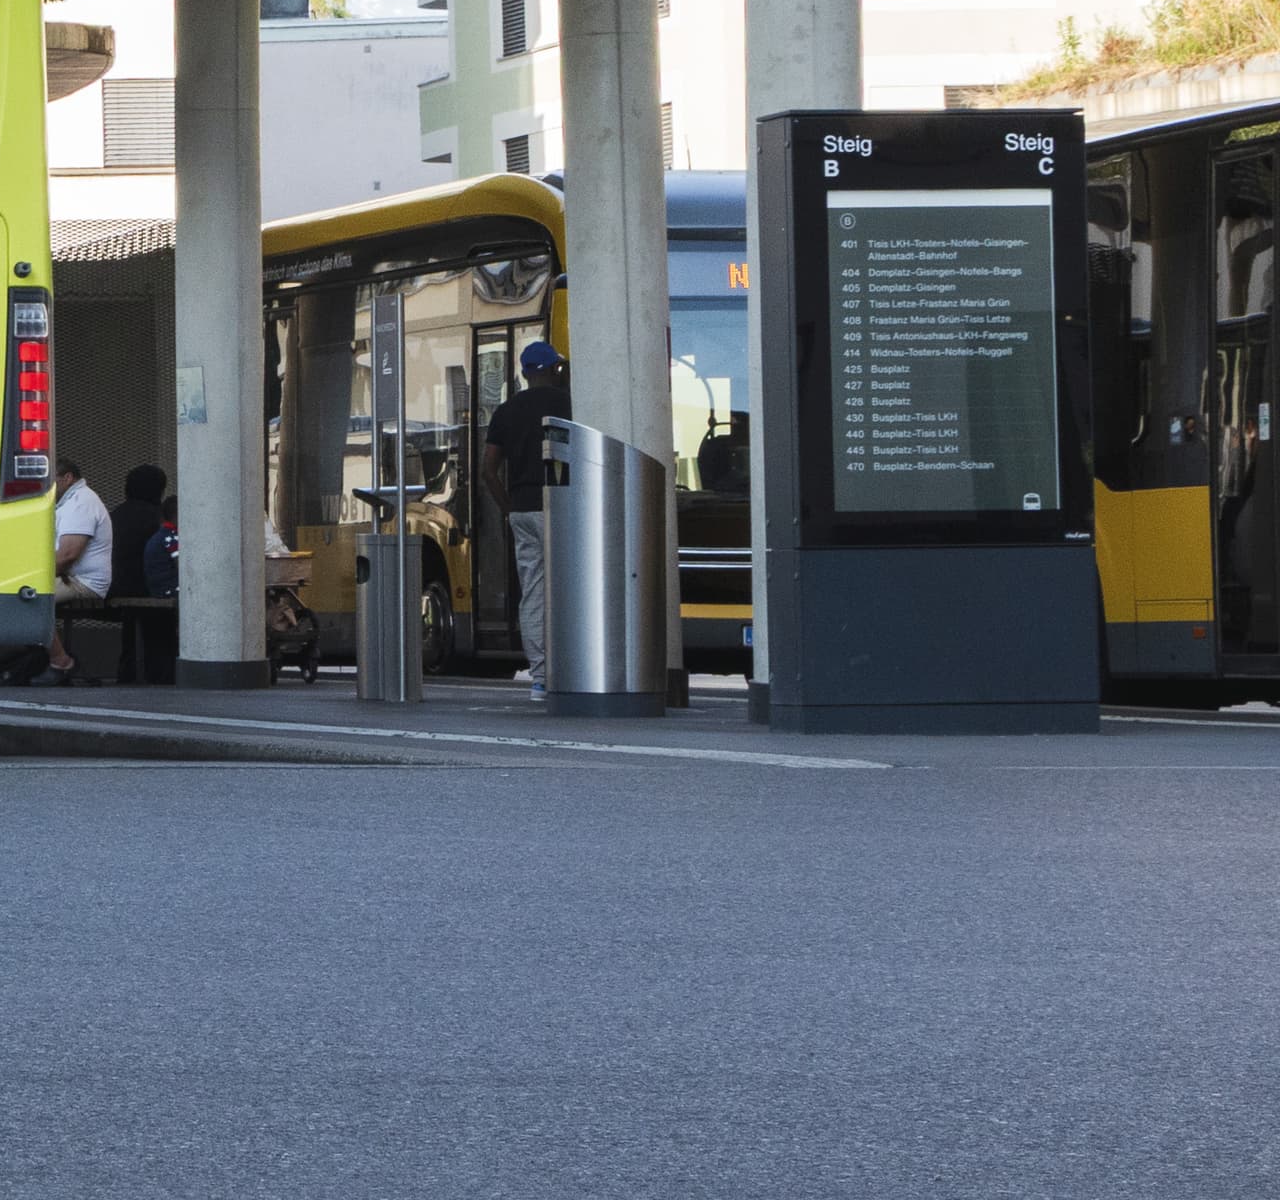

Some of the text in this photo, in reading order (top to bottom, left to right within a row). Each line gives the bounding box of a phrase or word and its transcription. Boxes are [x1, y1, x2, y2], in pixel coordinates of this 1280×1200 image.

[824, 135, 872, 157] Steig
[1005, 133, 1054, 155] Steig
[824, 160, 840, 177] B
[1039, 157, 1054, 175] C
[841, 240, 857, 248] 401
[868, 240, 888, 248] Tisis
[842, 269, 860, 277] 404
[842, 284, 860, 293] 405
[843, 300, 860, 309] 407
[870, 300, 890, 308] Tisis
[960, 299, 985, 307] Maria
[987, 298, 1010, 307] Grün
[870, 316, 908, 325] Frastanz
[910, 315, 935, 324] Maria
[986, 315, 1011, 323] Letze
[843, 333, 862, 341] 409
[870, 332, 890, 341] Tisis
[843, 349, 860, 357] 414
[844, 365, 910, 374] 425 Busplatz
[844, 380, 910, 390] 427 Busplatz
[872, 397, 911, 407] Busplatz
[845, 414, 864, 422] 430
[938, 413, 958, 421] LKH
[846, 430, 864, 438] 440
[938, 429, 958, 437] LKH
[846, 446, 865, 455] 445
[939, 445, 959, 454] LKH
[846, 462, 864, 471] 470
